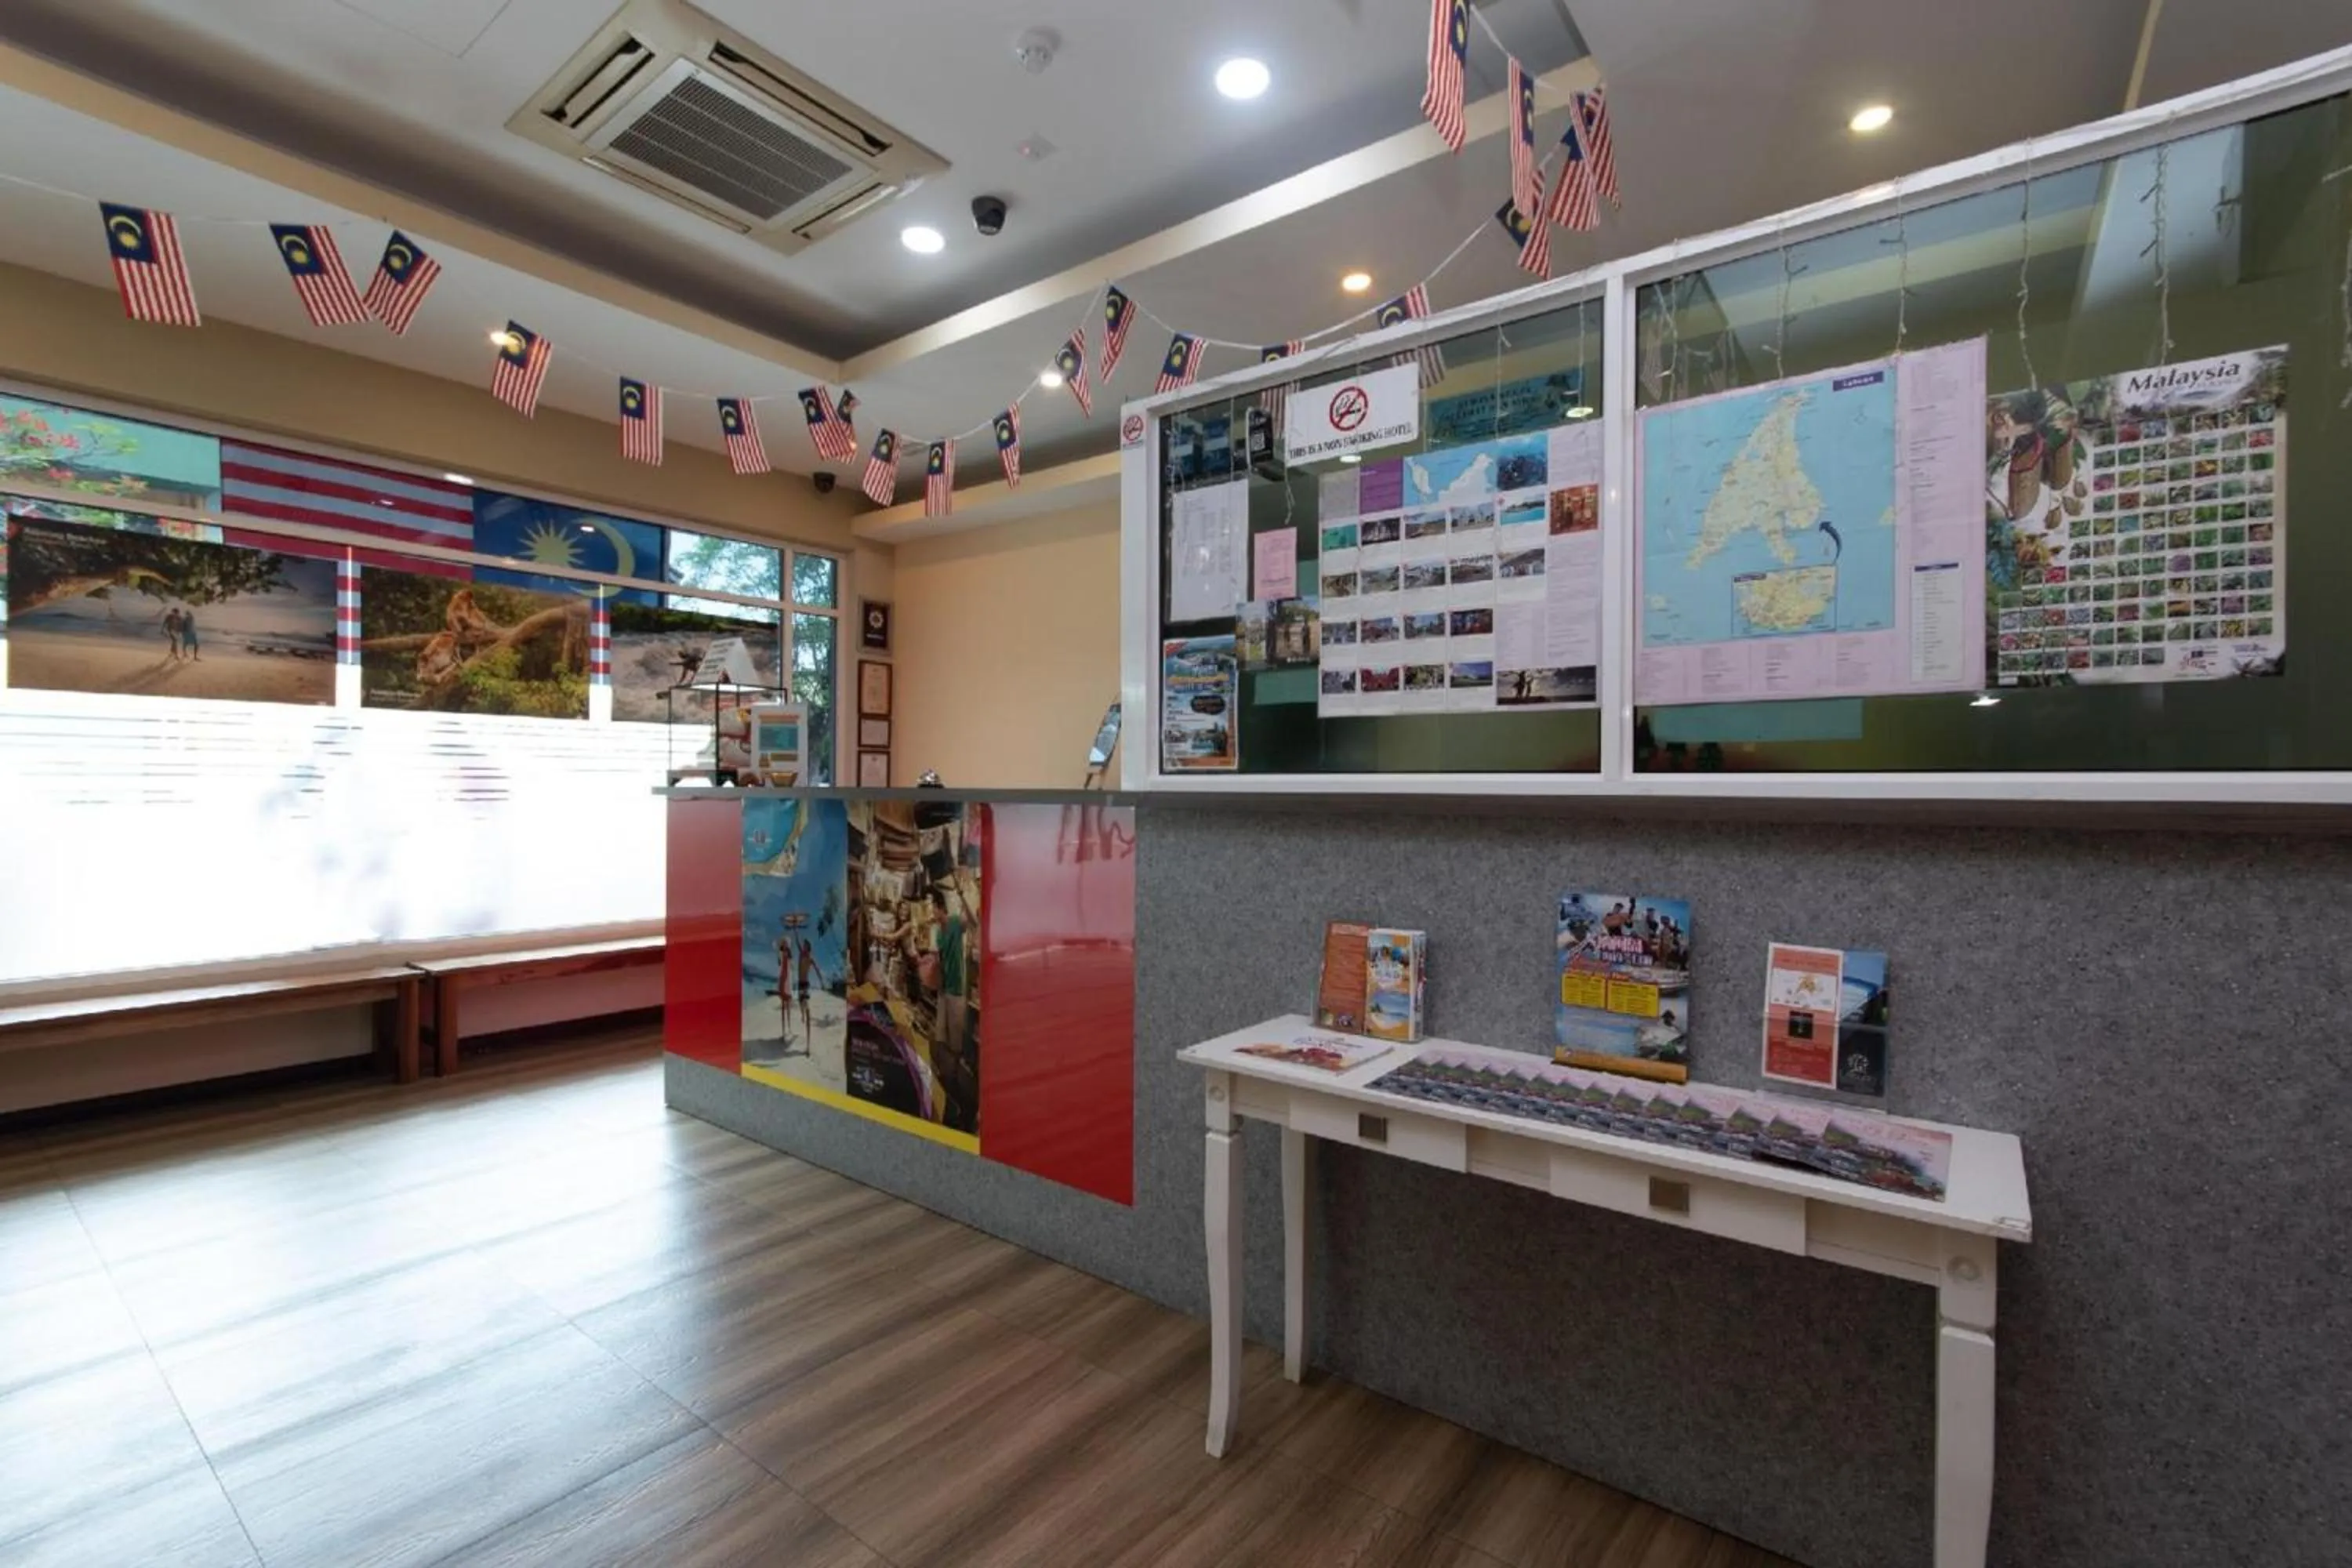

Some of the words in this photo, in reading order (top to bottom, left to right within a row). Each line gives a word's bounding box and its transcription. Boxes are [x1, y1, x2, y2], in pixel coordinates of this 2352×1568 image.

[2128, 360, 2240, 393] Malaysia
[1289, 447, 1306, 459] THIS
[1308, 445, 1316, 455] IS
[1323, 438, 1343, 452] NON
